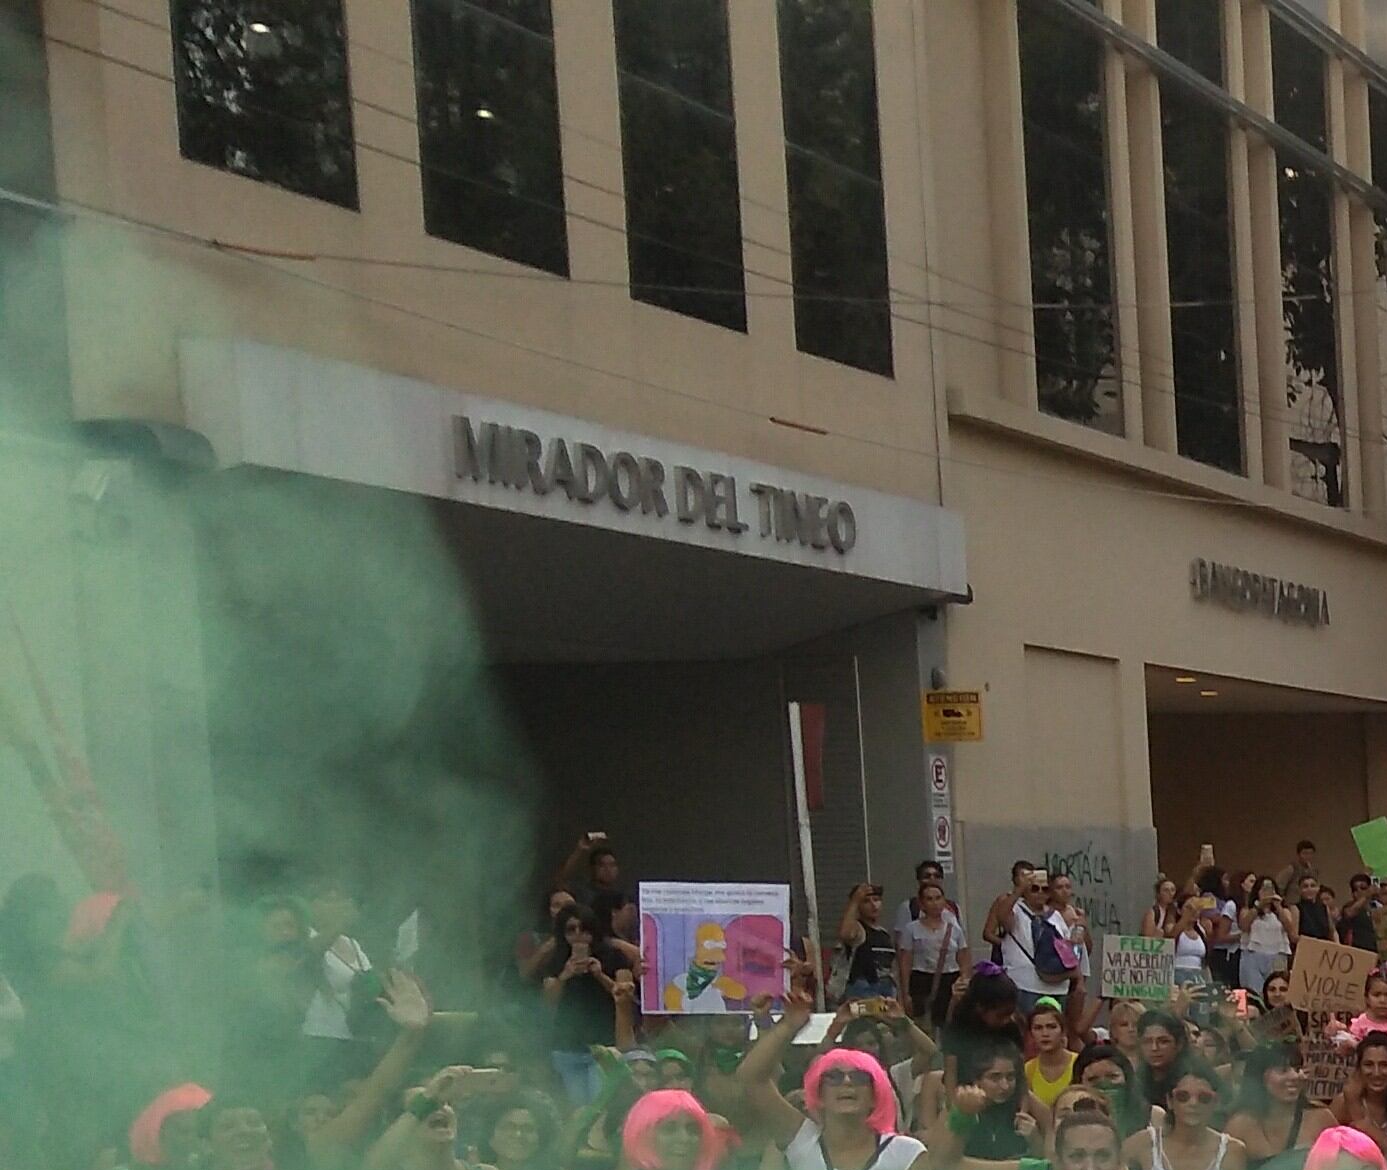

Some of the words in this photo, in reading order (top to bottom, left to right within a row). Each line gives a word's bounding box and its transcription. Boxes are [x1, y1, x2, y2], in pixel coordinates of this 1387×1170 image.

[450, 414, 669, 517] MIRADOR
[674, 465, 749, 533] DEL
[1120, 937, 1165, 953] FELIZ
[1320, 949, 1354, 973] NO
[1103, 968, 1126, 985] QUE
[1129, 970, 1143, 985] NO
[1311, 1011, 1353, 1028] SAER
